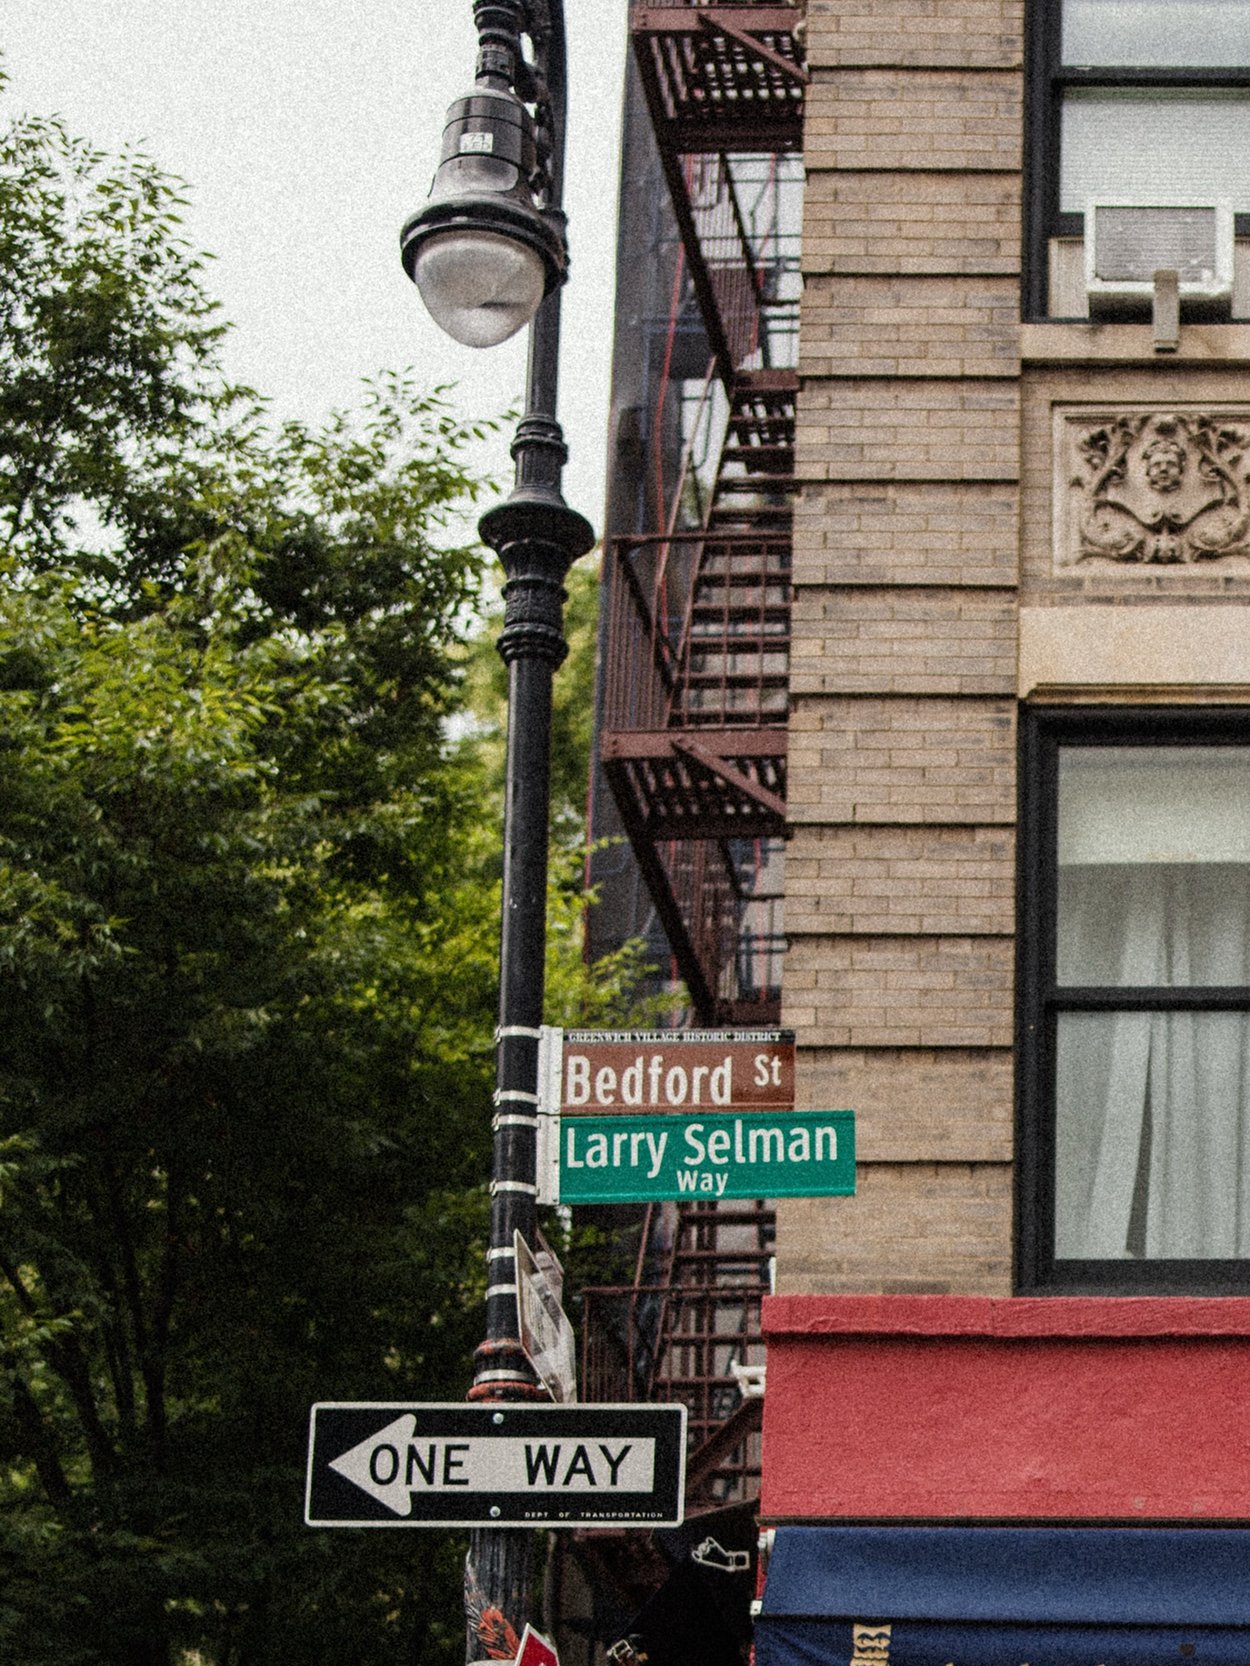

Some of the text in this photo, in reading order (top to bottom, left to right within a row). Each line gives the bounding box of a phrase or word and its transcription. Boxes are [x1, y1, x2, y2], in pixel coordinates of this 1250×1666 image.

[568, 1031, 781, 1043] GREENWICH VILLAGE HISTORIC DISTRICT
[566, 1053, 782, 1106] Bedford St
[566, 1119, 838, 1179] Larry Selman
[676, 1170, 729, 1196] Way
[369, 1443, 632, 1486] ONE WAY
[524, 1511, 664, 1519] DEPT OF TRANSPORTATION
